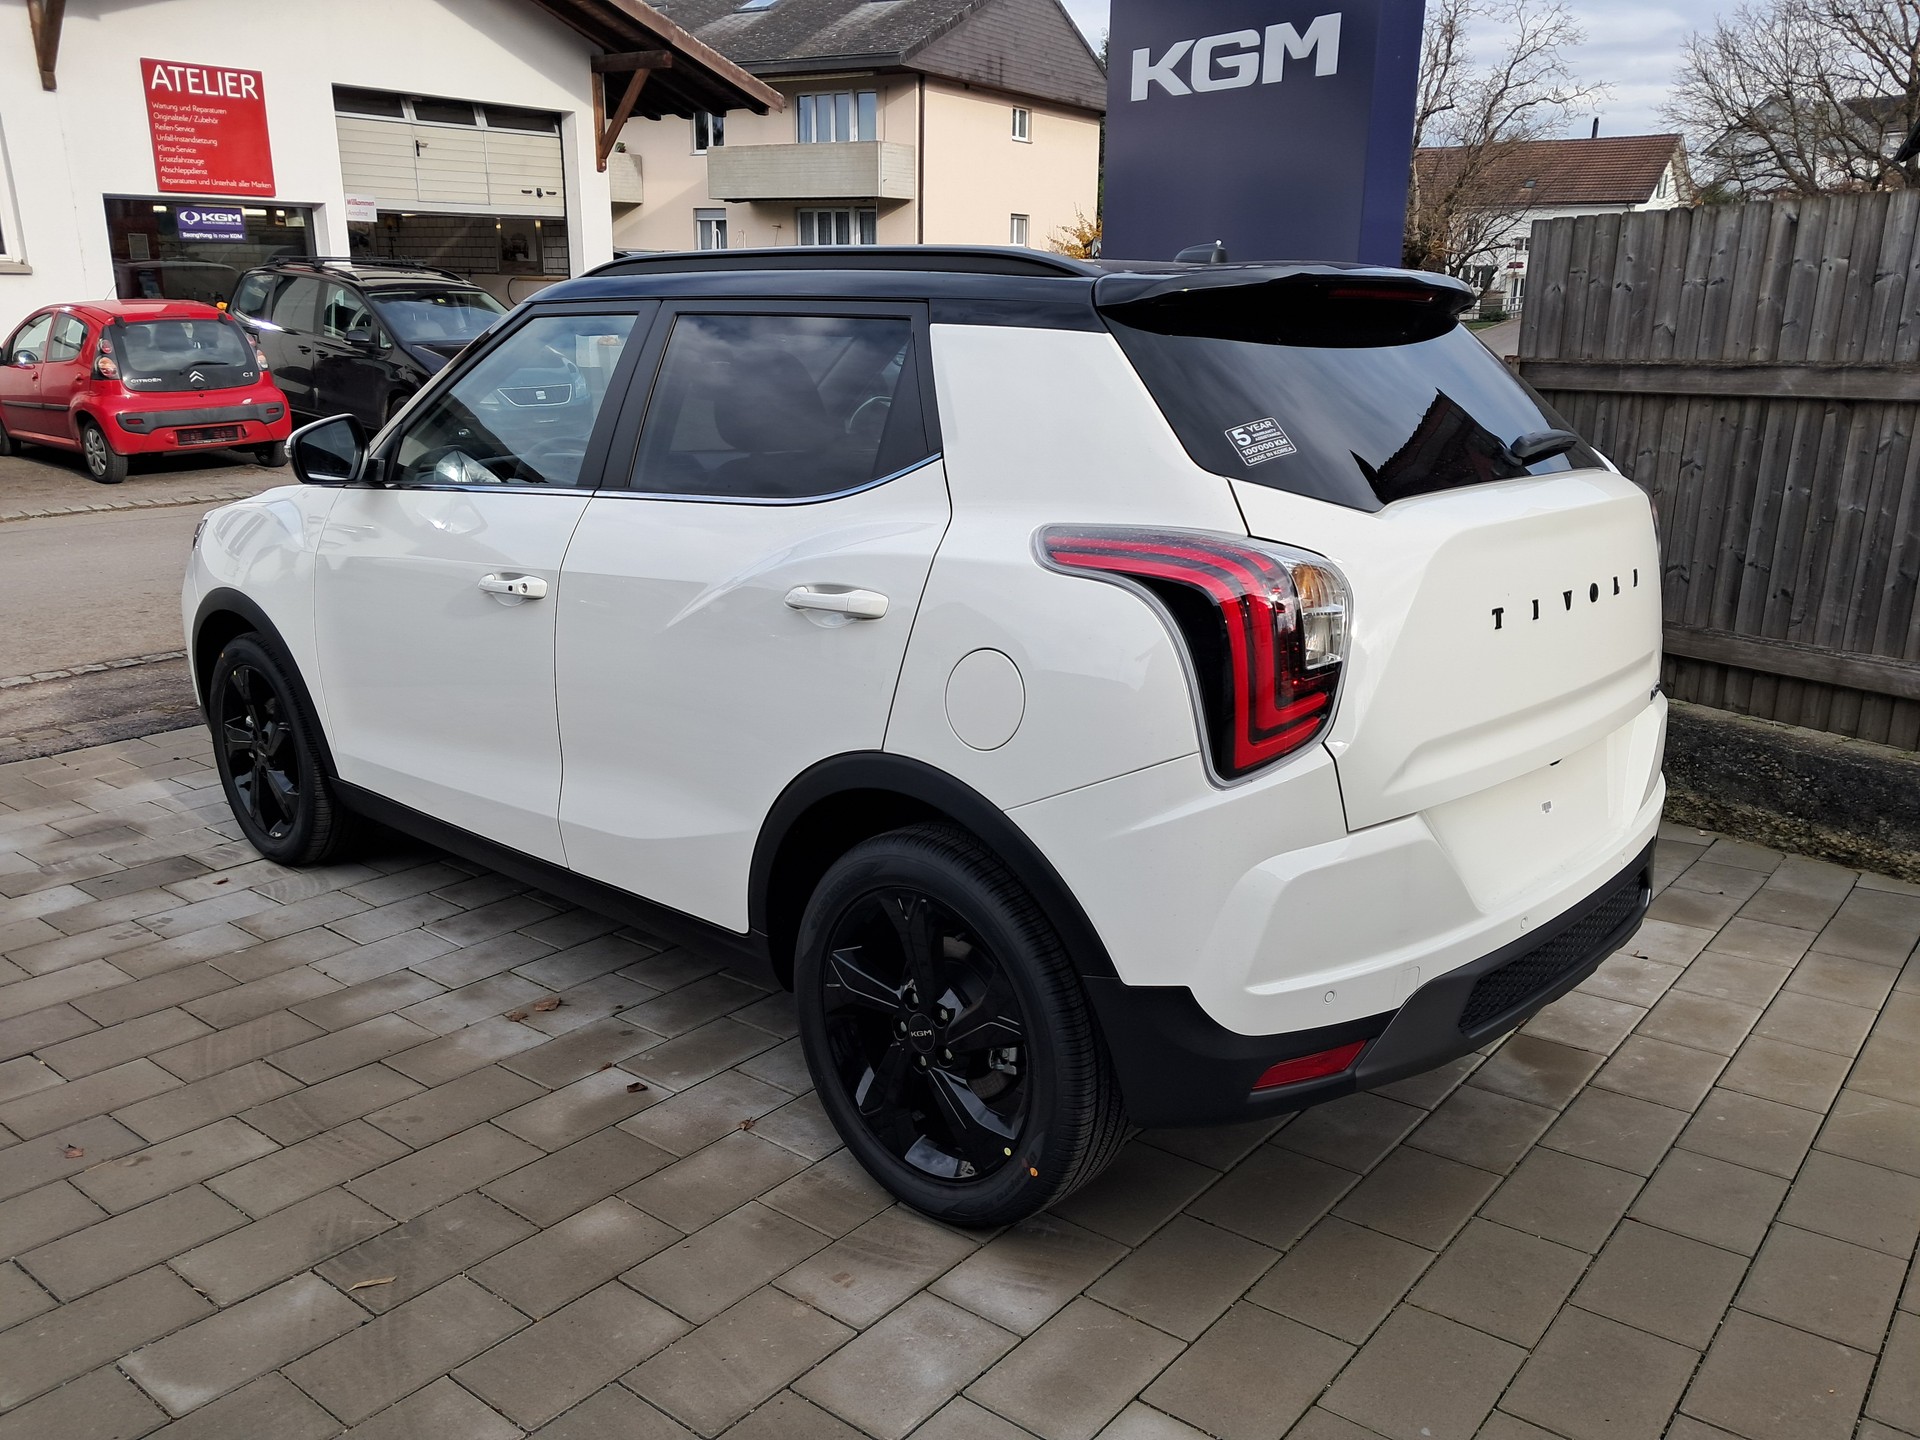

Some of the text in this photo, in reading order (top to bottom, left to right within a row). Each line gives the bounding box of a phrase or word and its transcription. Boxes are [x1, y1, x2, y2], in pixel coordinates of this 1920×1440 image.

[1131, 12, 1342, 101] KGM
[151, 64, 259, 99] ATELIER
[151, 102, 178, 112] Wartung
[192, 105, 227, 114] Reparaturen
[155, 123, 195, 132] Reifen-Service
[158, 144, 197, 153] Klima-Service
[159, 155, 205, 166] Ersatzfahrzeuge
[161, 166, 208, 175] Abschleppdienst
[162, 176, 197, 185] Reparaturen
[211, 178, 237, 187] Unterhalt
[202, 213, 241, 222] KGM
[1231, 420, 1273, 446] 5 YEAR
[1242, 438, 1288, 456] 100'000 KM
[1247, 453, 1267, 463] MADE
[1273, 446, 1293, 455] KOREA
[1491, 568, 1638, 630] TIVOLI
[911, 1029, 932, 1037] KGM
